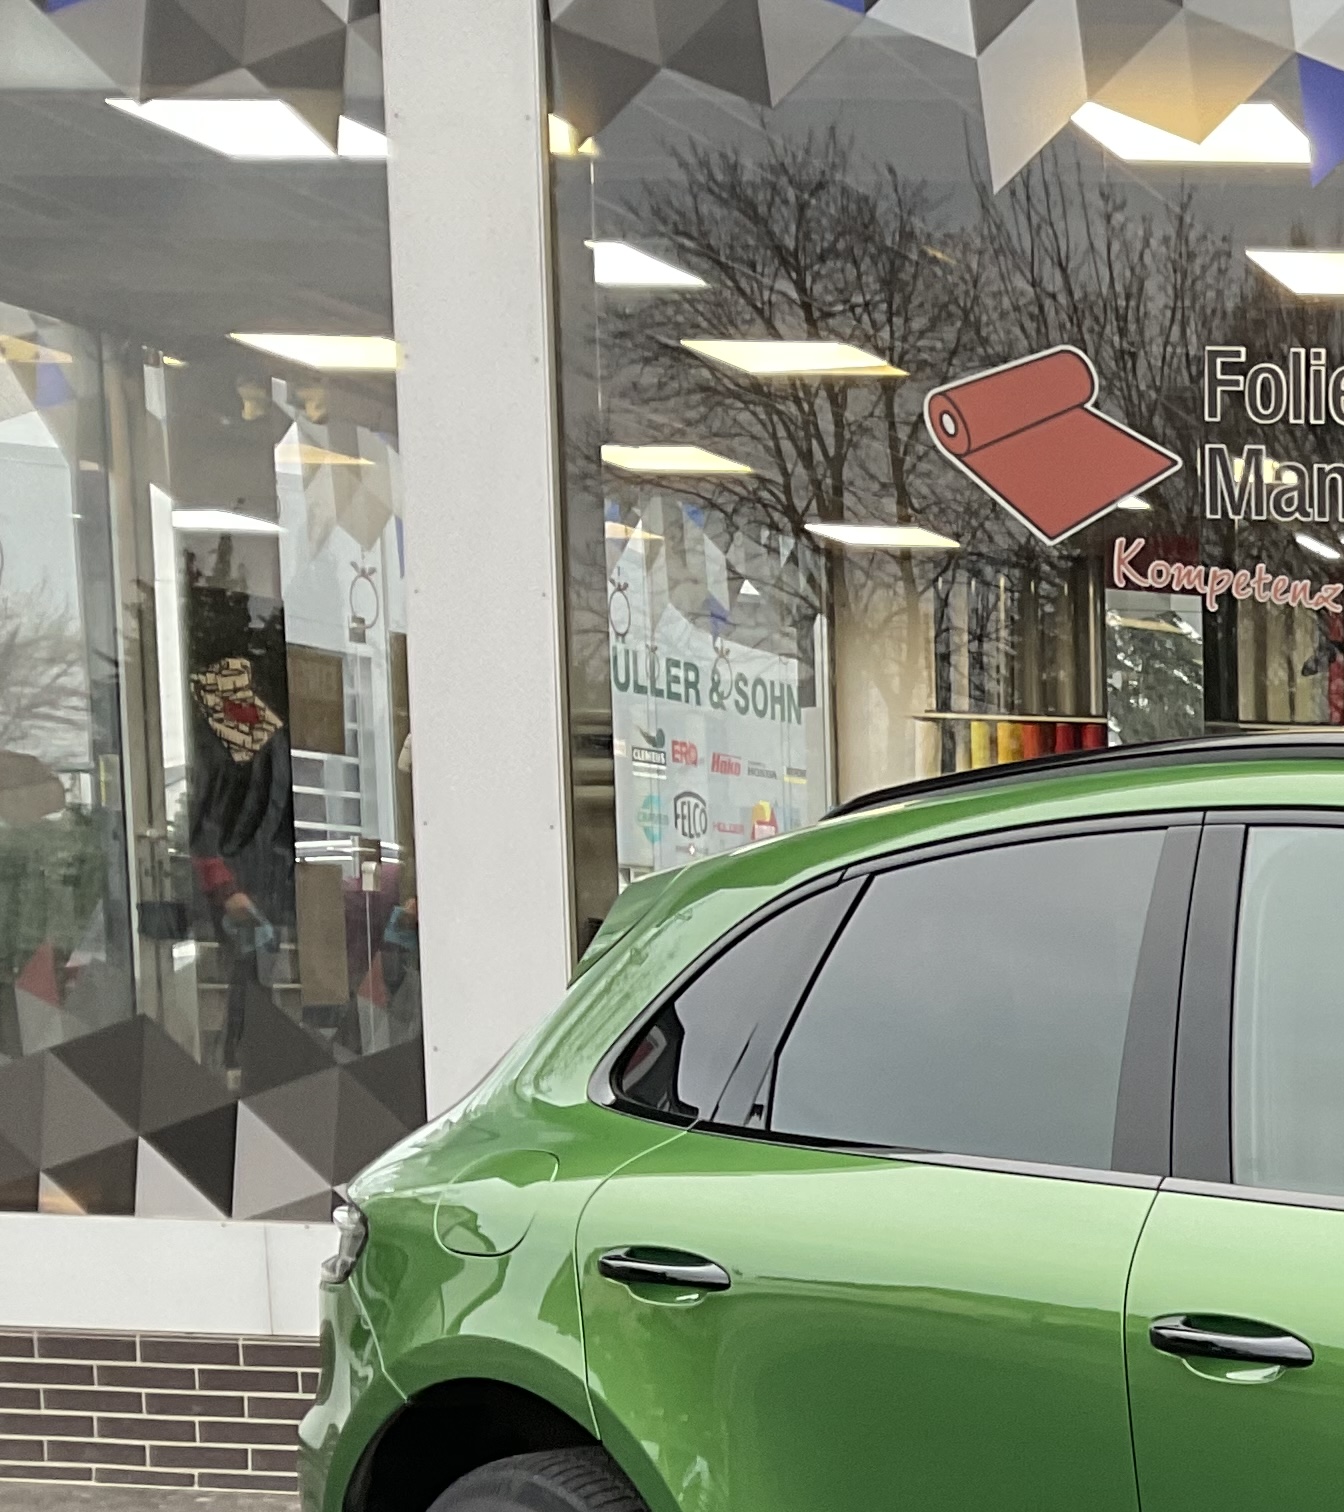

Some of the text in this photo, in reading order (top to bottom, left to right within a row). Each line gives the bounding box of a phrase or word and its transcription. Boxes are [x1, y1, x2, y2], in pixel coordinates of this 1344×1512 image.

[1112, 536, 1342, 613] Kompetenz
[709, 667, 727, 711] &
[734, 672, 802, 725] SOHN
[673, 791, 708, 839] FELCO
